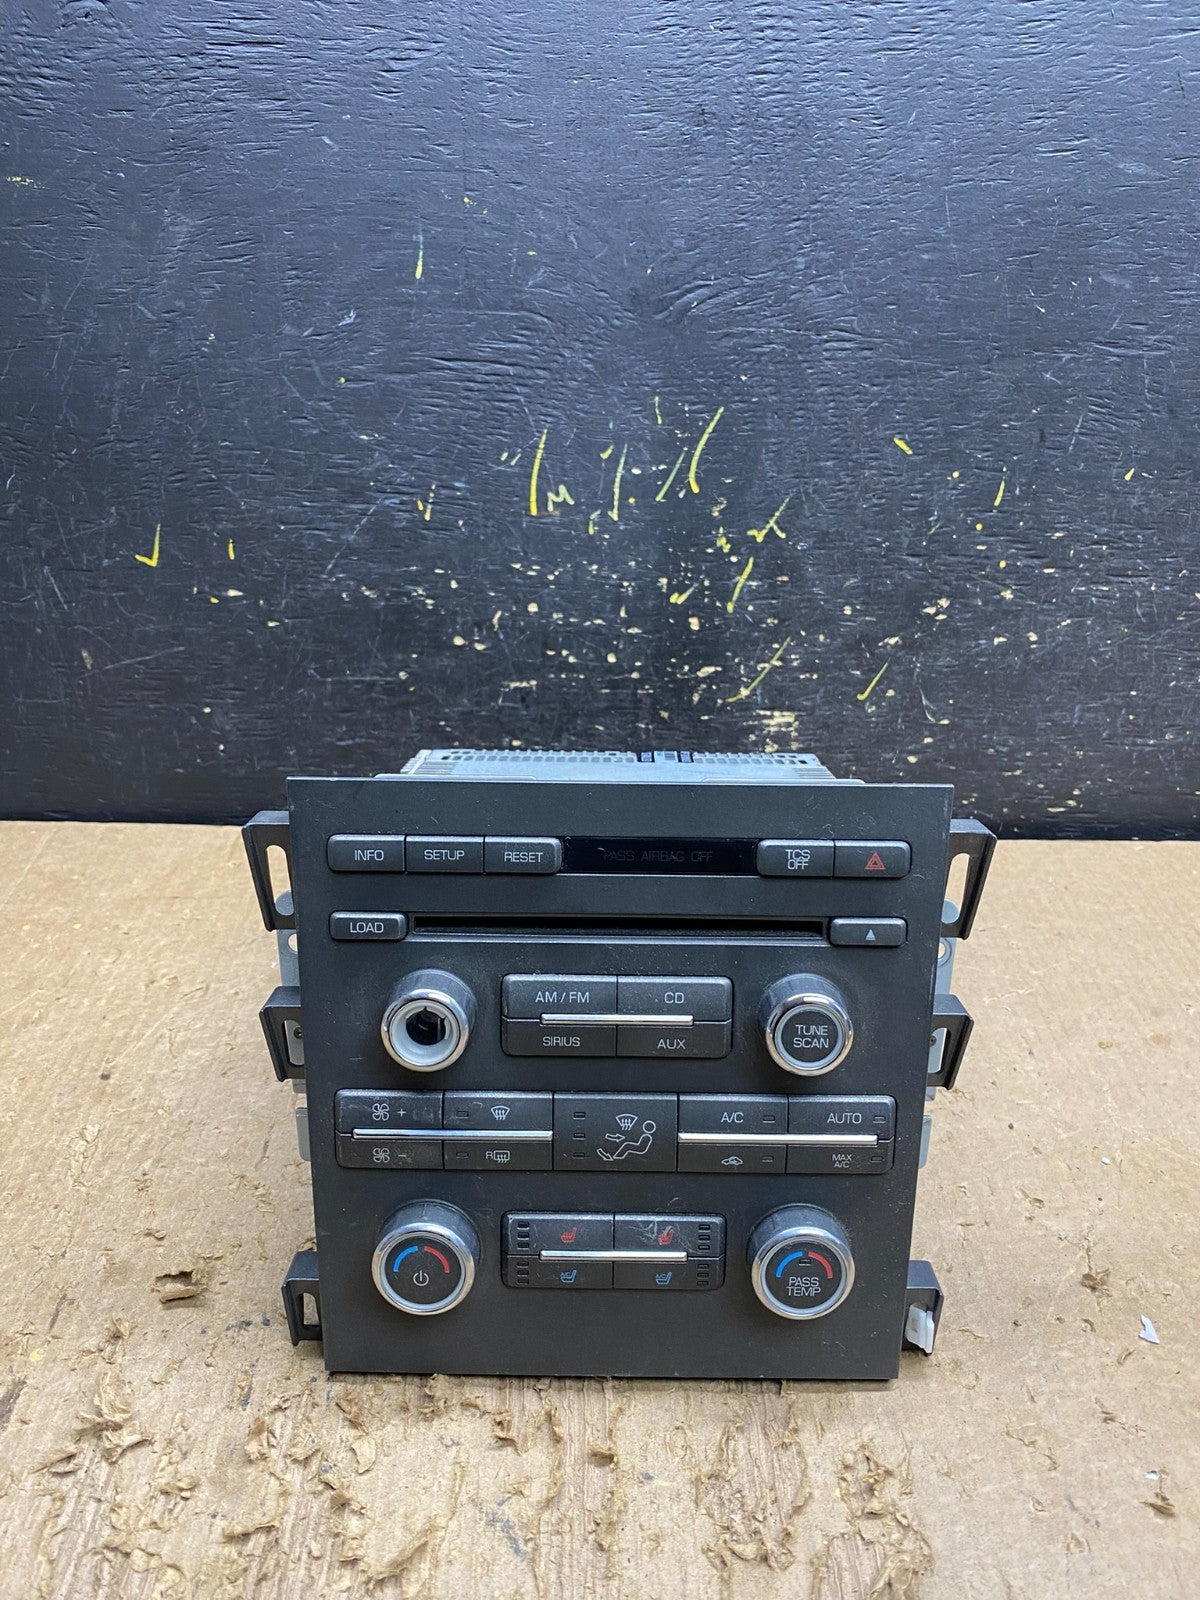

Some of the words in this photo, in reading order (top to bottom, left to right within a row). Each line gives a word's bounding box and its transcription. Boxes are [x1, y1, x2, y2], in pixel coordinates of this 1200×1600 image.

[354, 849, 384, 862] INFO
[423, 849, 465, 861] SETUP
[504, 851, 544, 863] RESET
[603, 850, 635, 861] PASS
[641, 850, 686, 862] AIRBAG
[691, 851, 713, 862] OFF
[785, 849, 811, 860] TCS
[787, 859, 809, 870] OFF
[349, 921, 384, 933] LOAD
[664, 991, 685, 1004] CD
[795, 1024, 828, 1036] TUNE
[542, 1036, 581, 1047] SIRIUS
[657, 1039, 686, 1050] AUX
[793, 1036, 829, 1049] SCAN
[720, 1111, 744, 1123] A/C
[826, 1112, 862, 1124] AUTO
[832, 1153, 852, 1161] MAX
[834, 1160, 850, 1168] A/C
[788, 1276, 819, 1287] PASS
[786, 1286, 821, 1297] TEMP
